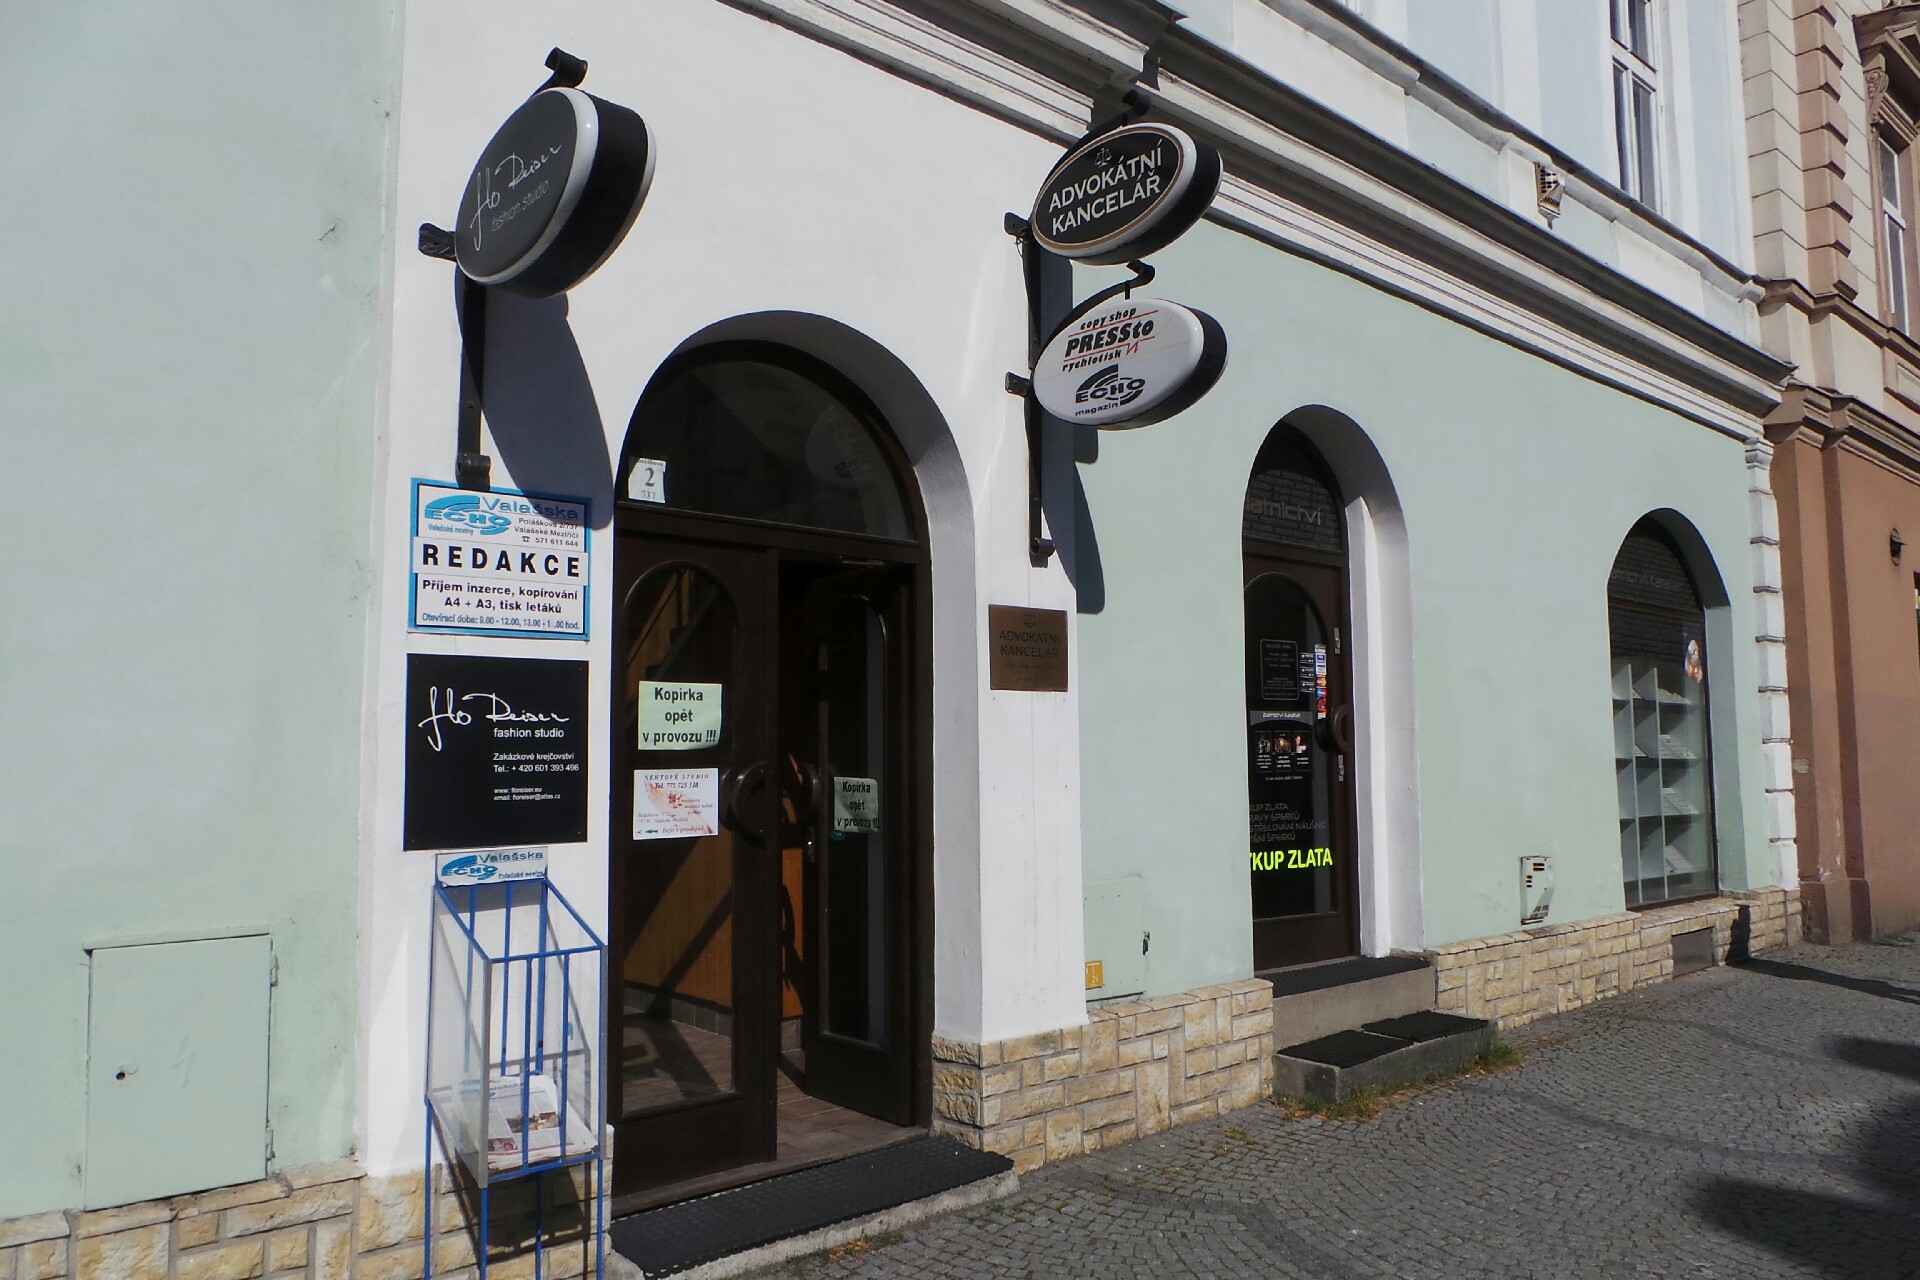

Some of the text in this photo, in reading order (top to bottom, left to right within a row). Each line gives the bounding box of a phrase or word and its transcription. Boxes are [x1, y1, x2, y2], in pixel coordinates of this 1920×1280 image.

[1049, 138, 1164, 214] ADVOKÁTNÍ
[522, 180, 549, 211] studio
[1052, 171, 1160, 236] KANCELÁŘ
[1079, 307, 1137, 331] copy shop
[1064, 319, 1155, 358] PRESSto
[1061, 348, 1122, 373] rychlotisk
[1075, 376, 1146, 404] ECHO
[1074, 402, 1119, 417] magazin
[644, 466, 655, 488] 2
[641, 489, 656, 501] 737
[482, 496, 579, 520] Valašska
[425, 508, 512, 527] ECHO
[518, 517, 579, 531] Poláškova 2/737
[514, 526, 549, 536] Valašské
[535, 537, 548, 545] 571
[551, 538, 563, 546] 611
[423, 543, 580, 578] REDAKCE
[422, 579, 578, 601] Příjem inzerce, kopírování
[444, 597, 460, 607] A4
[476, 598, 496, 611] A3,
[499, 600, 522, 611] tisk
[526, 602, 562, 614] letáků
[422, 612, 456, 623] Otevírací
[457, 614, 478, 624] doba:
[479, 615, 494, 625] 9.00
[501, 616, 522, 627] 12.00,
[523, 617, 541, 627] 13.00
[565, 620, 580, 630] hod.
[654, 686, 704, 704] Kopírka
[665, 708, 693, 726] opět
[493, 728, 565, 738] fashion studio
[642, 729, 717, 746] v provozu !!!
[493, 752, 575, 762] Zakázkové krejčovství
[518, 764, 534, 772] 420
[534, 764, 549, 772] 601
[550, 764, 565, 772] 393
[565, 763, 580, 772] 496
[842, 781, 871, 795] Kopírka
[849, 799, 865, 812] opět
[1265, 803, 1289, 811] ZLATA
[837, 817, 842, 827] v
[844, 818, 871, 829] provozu
[478, 851, 544, 863] Valašska
[1250, 847, 1334, 872] KUP ZLATA
[441, 865, 498, 877] ECHO
